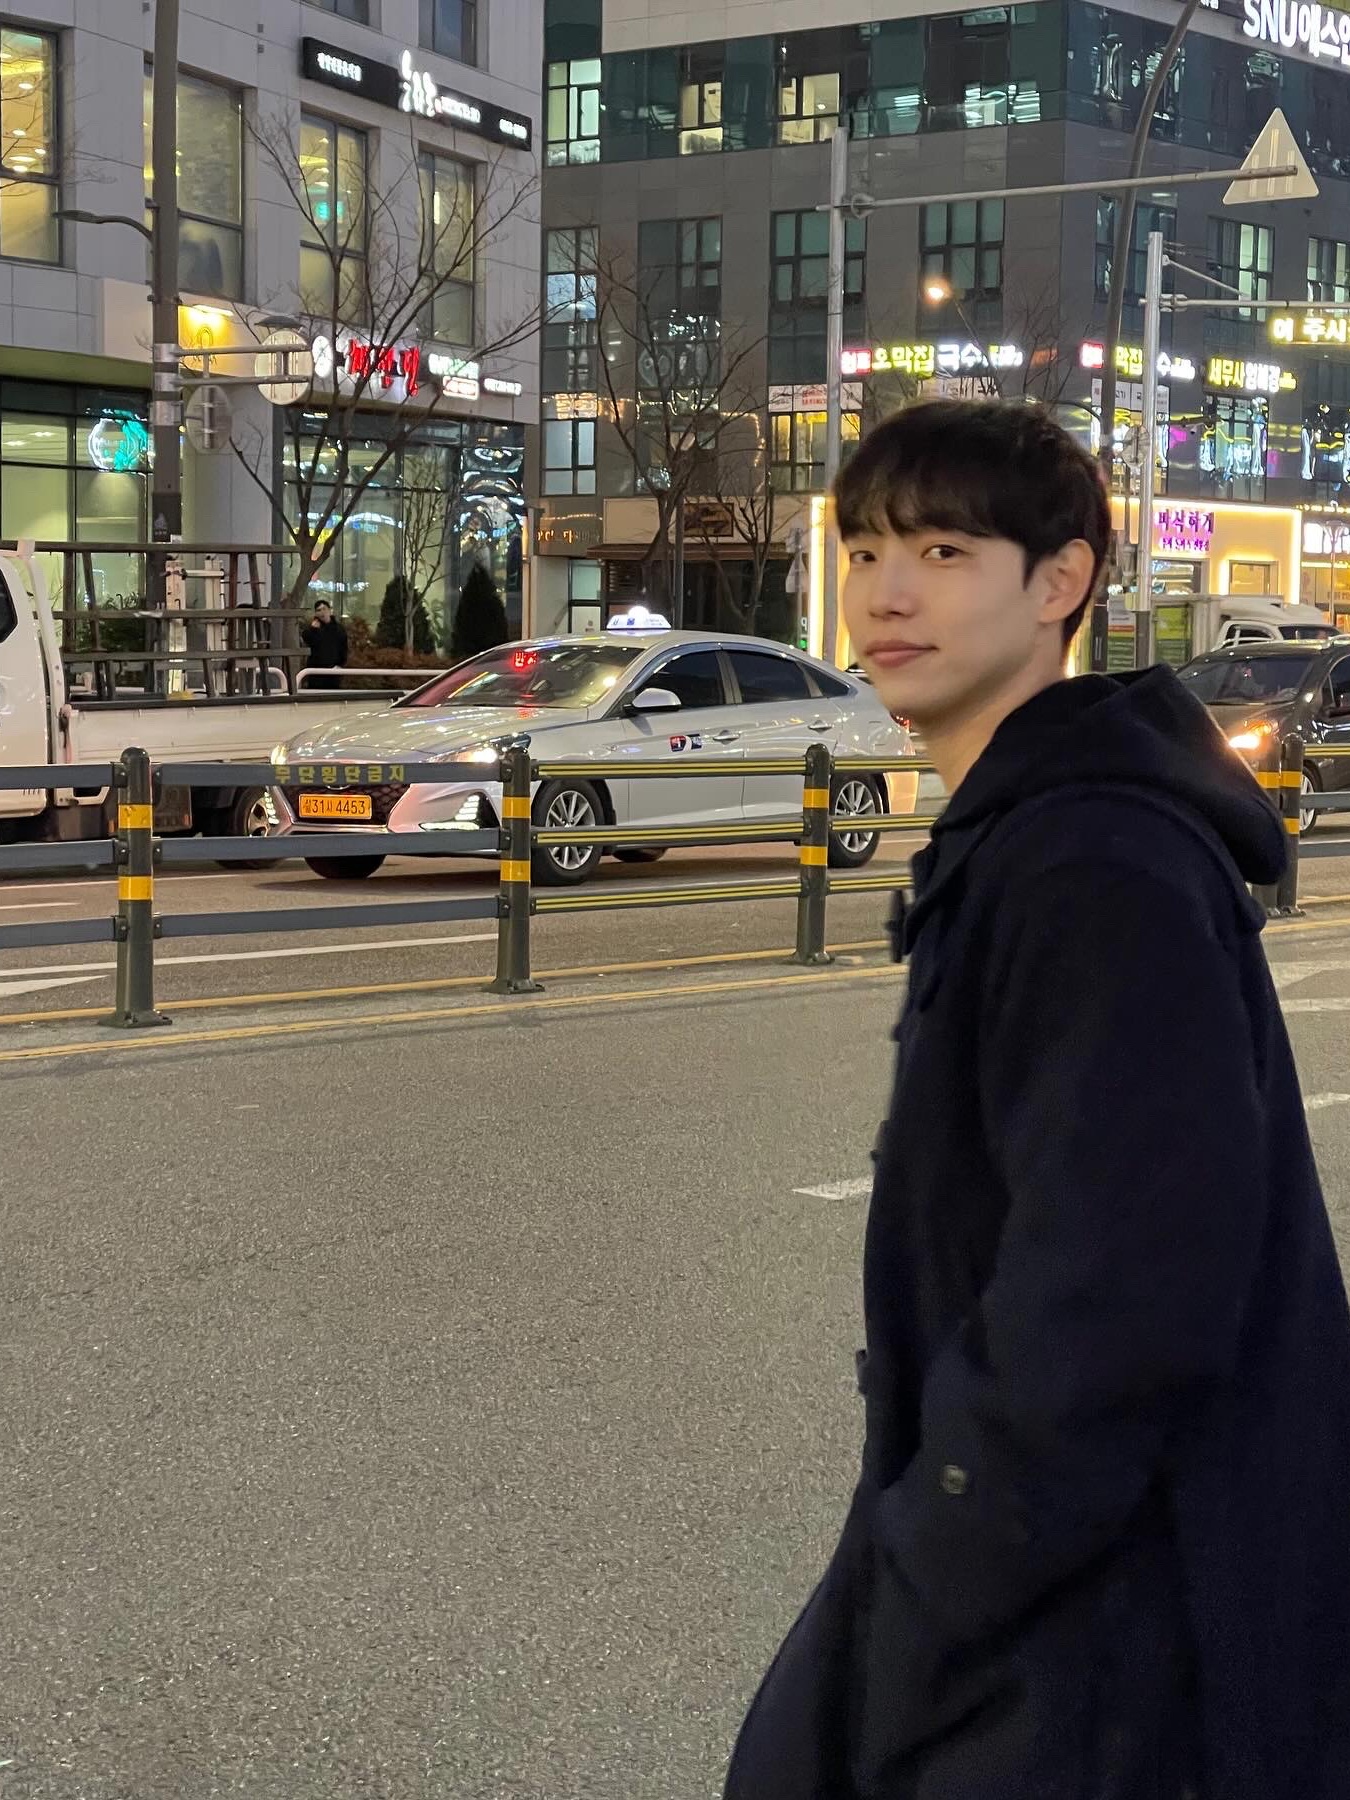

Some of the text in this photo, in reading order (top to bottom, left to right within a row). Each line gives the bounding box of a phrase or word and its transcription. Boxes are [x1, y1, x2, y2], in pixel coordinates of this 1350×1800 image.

[1115, 346, 1142, 375] 막집
[275, 765, 405, 784] 무단횡단금지
[335, 800, 366, 815] 4453
